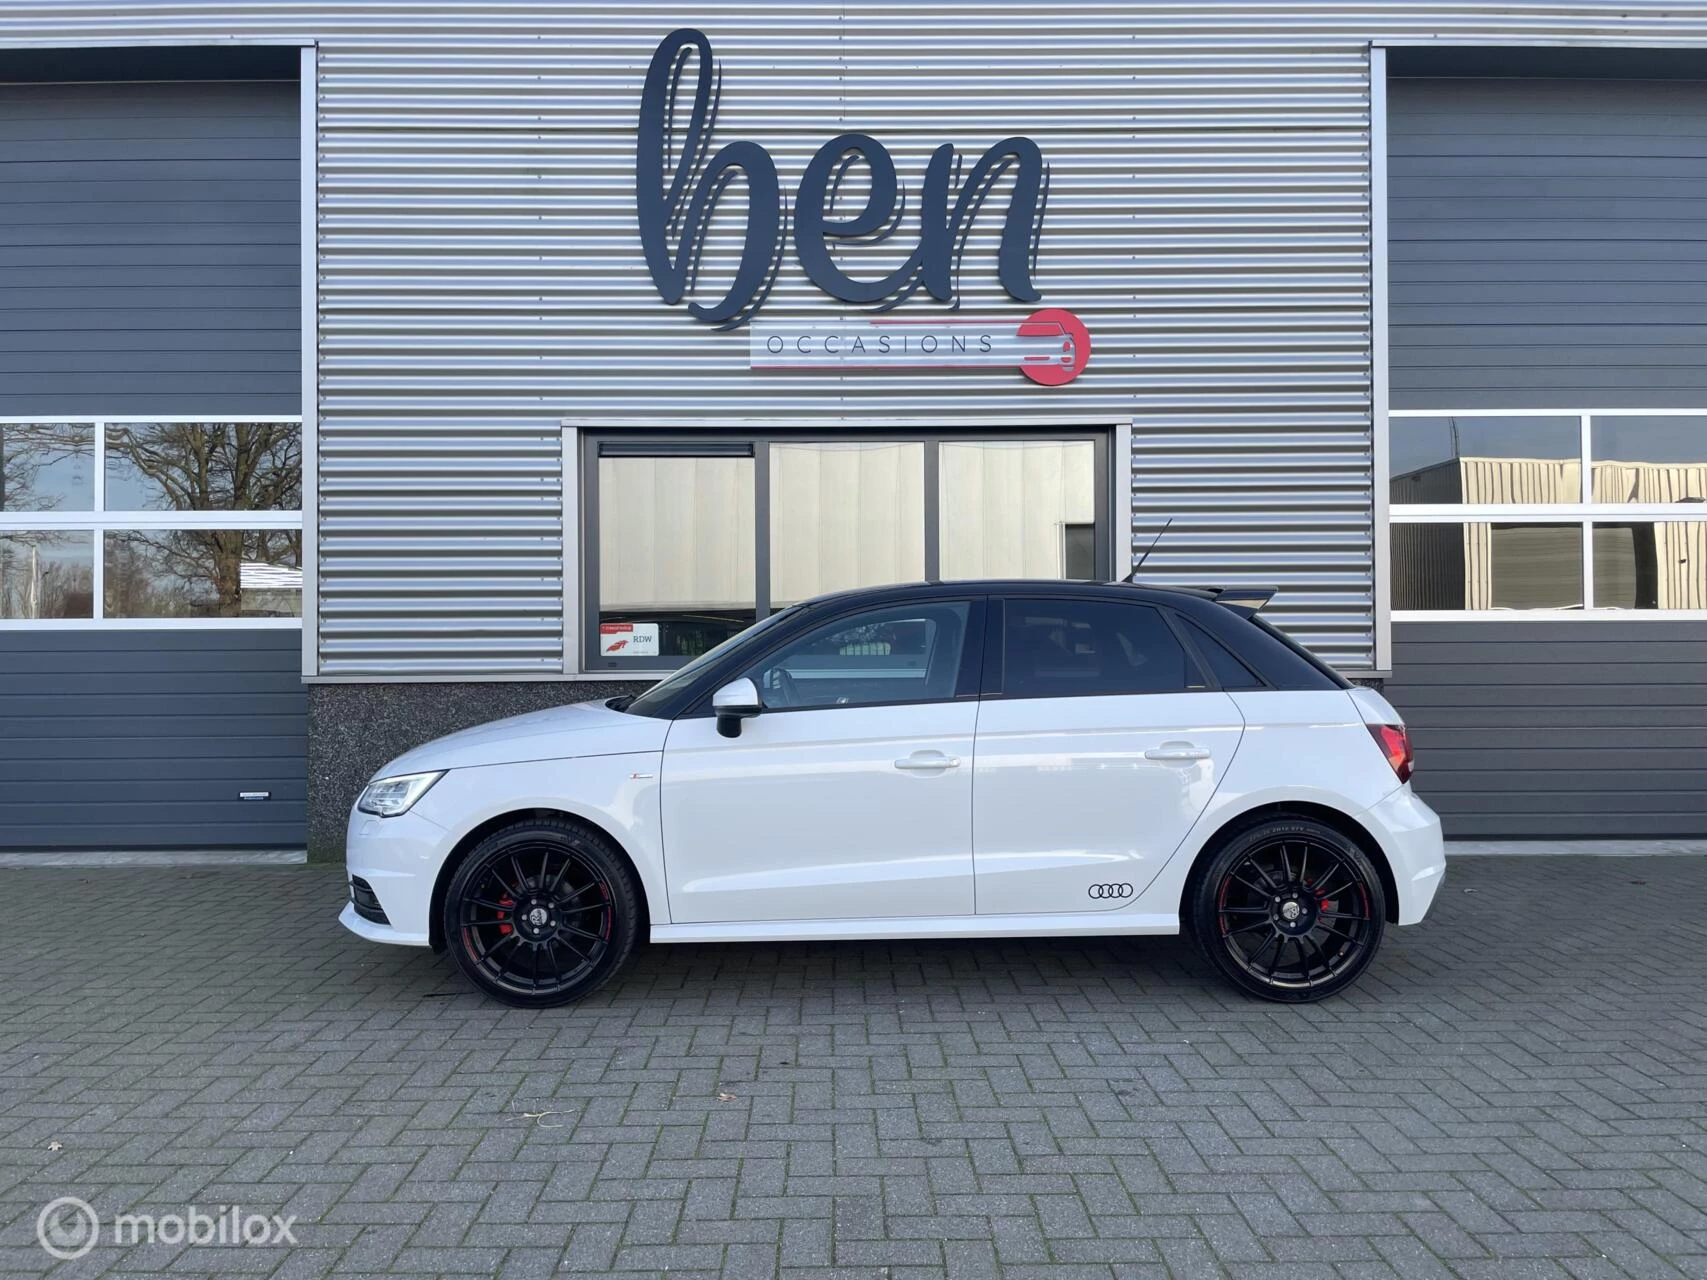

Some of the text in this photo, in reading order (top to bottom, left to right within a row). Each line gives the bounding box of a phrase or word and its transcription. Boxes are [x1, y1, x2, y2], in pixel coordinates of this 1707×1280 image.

[636, 27, 1043, 324] ben
[766, 334, 992, 354] OCCASIONS
[633, 635, 652, 643] RDW
